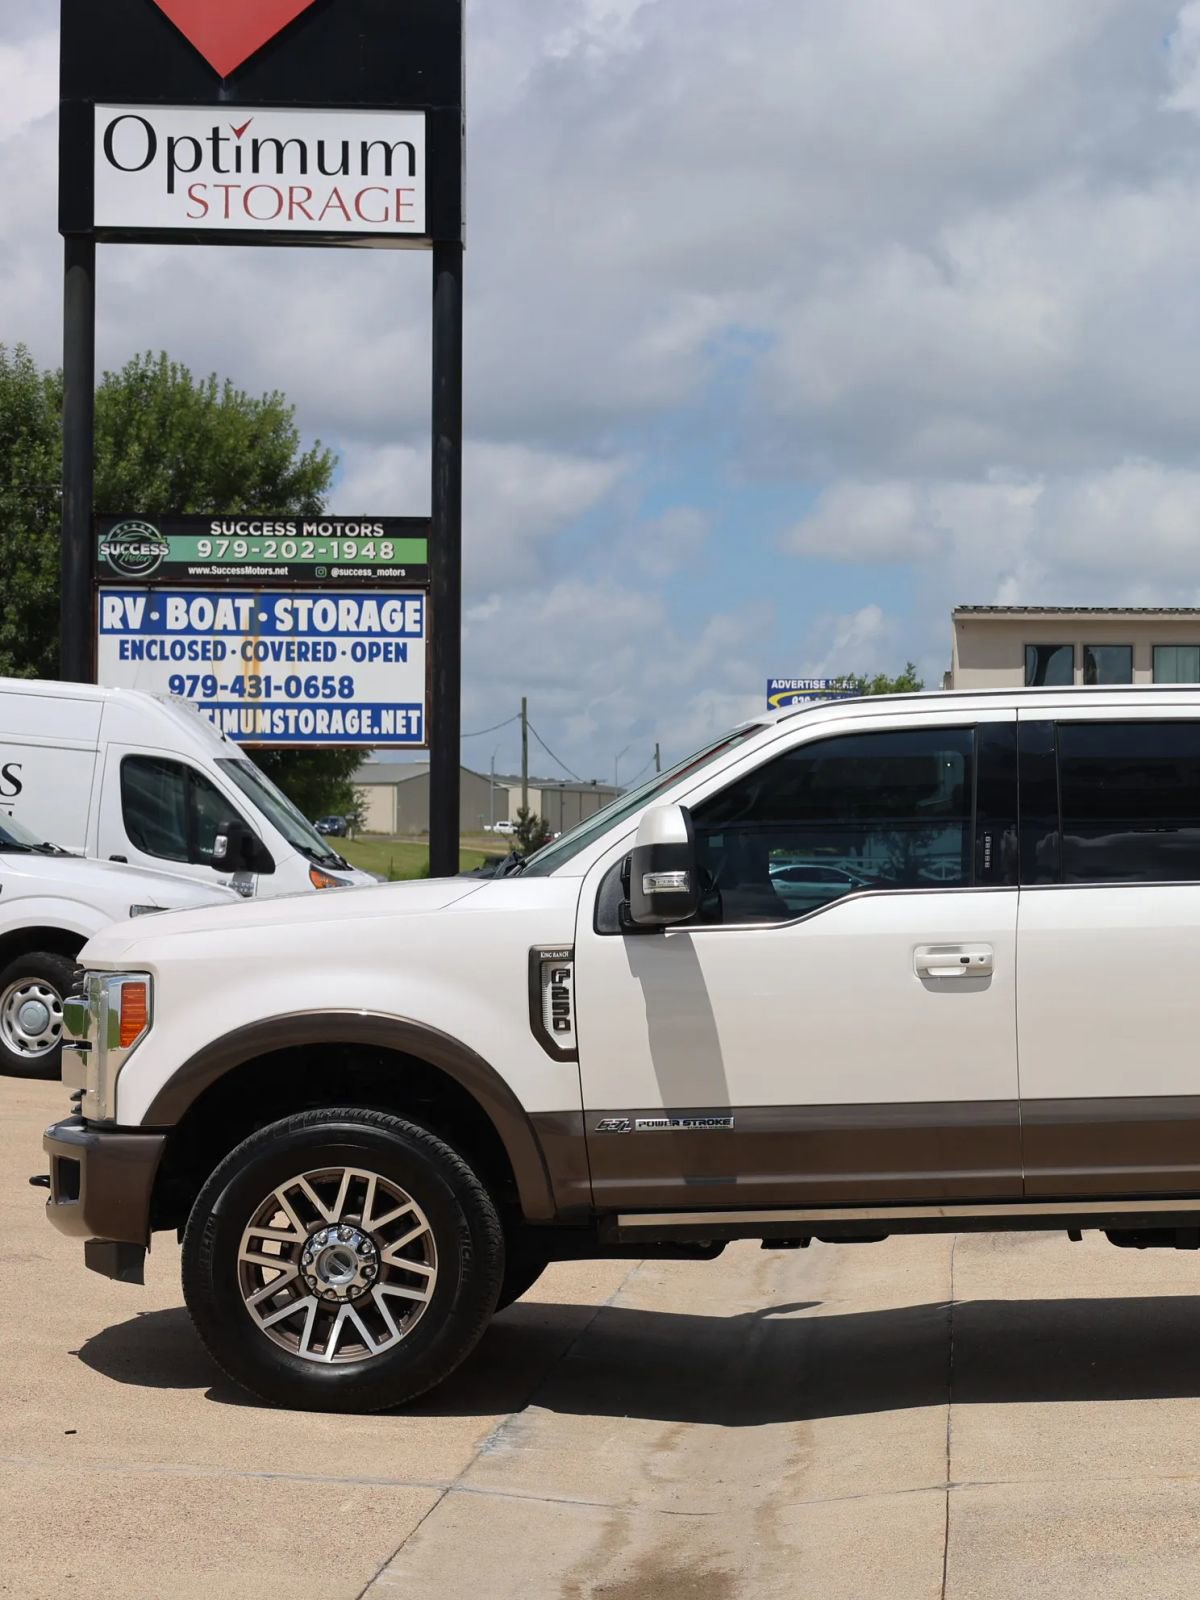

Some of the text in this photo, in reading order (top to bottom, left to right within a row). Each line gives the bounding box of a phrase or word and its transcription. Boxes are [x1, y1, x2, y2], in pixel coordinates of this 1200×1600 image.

[103, 114, 416, 194] Optimum
[186, 183, 415, 223] STORAGE
[210, 521, 384, 537] SUCCESS MOTORS
[100, 543, 169, 556] SUCCESS
[197, 540, 395, 560] 979-202-1948
[188, 565, 406, 578] www.SuccessMotors.net @success_motors
[102, 596, 421, 633] RV BOAT STORAGE
[119, 639, 408, 663] ENCLOSED COVERED OPEN
[168, 674, 355, 699] 979-431-0658
[771, 680, 826, 689] ADVERTISE
[638, 1118, 731, 1128] POWER STROKE
